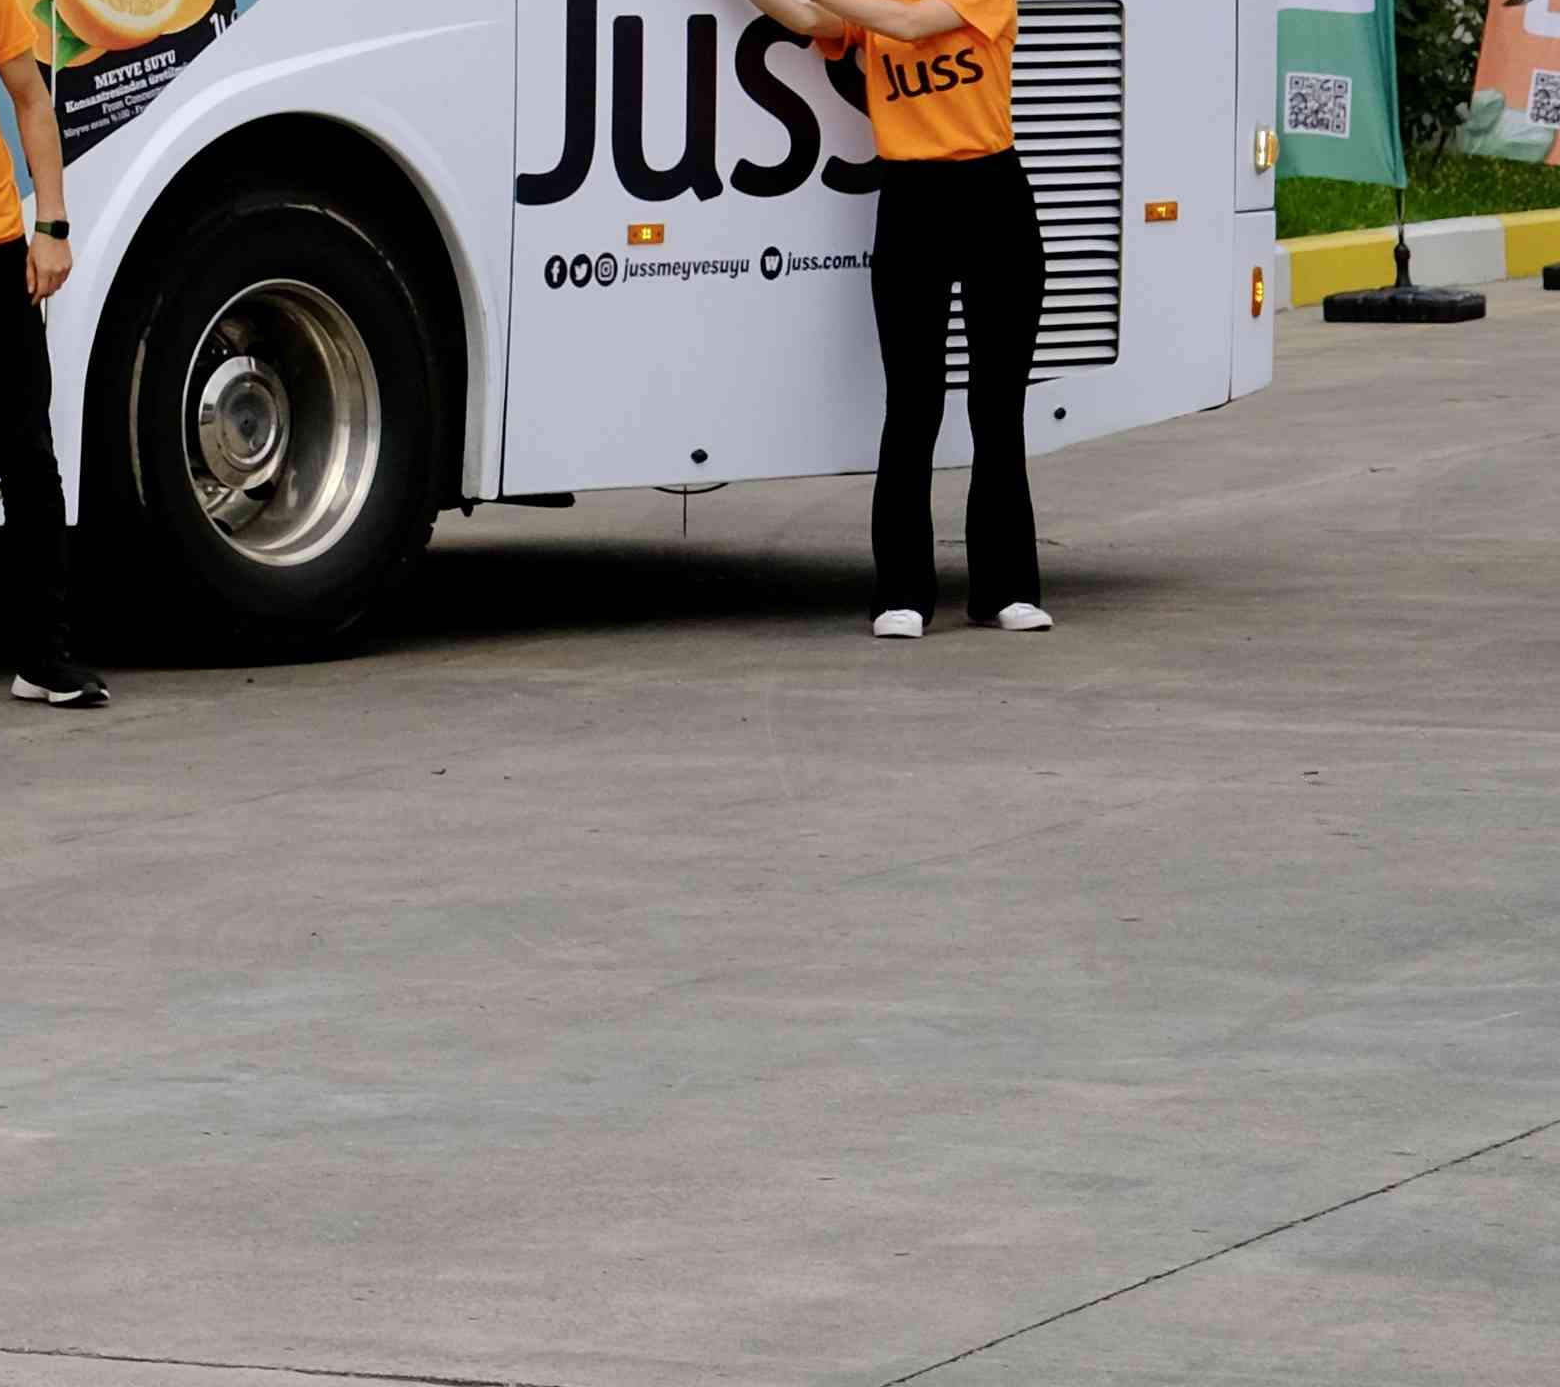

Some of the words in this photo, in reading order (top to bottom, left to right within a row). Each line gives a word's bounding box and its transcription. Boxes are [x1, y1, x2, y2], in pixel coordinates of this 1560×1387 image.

[94, 61, 143, 89] MEYVE
[145, 49, 177, 73] SUYU
[882, 47, 984, 102] Juss
[623, 257, 750, 283] jussmeyvesuyu
